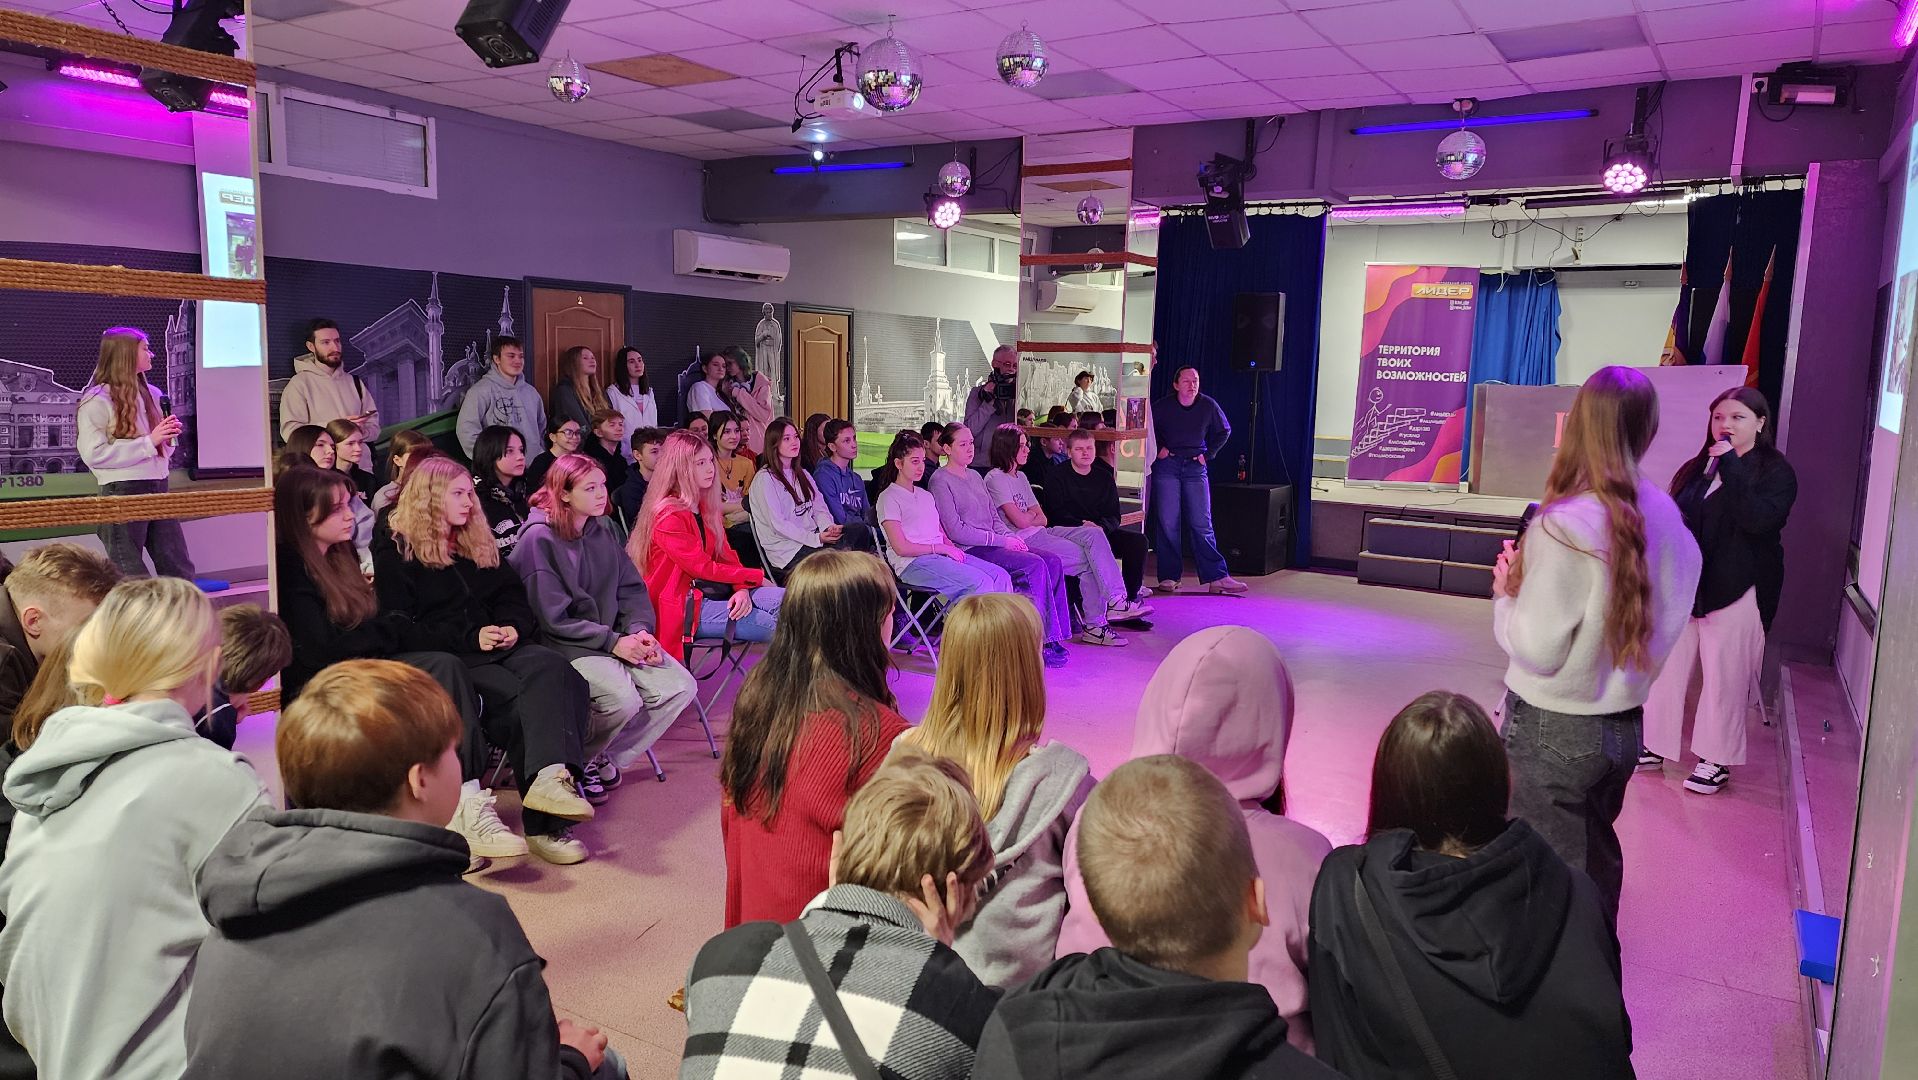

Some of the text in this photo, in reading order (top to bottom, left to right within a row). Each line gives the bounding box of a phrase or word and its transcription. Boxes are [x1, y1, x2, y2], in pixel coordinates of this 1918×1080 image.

[1416, 287, 1470, 296] ЛИДЕР
[1378, 345, 1440, 356] ТЕРРИТОРИЯ
[1377, 358, 1411, 367] ТВОИХ
[1376, 370, 1467, 382] ВОЗМОЖНОСТЕЙ
